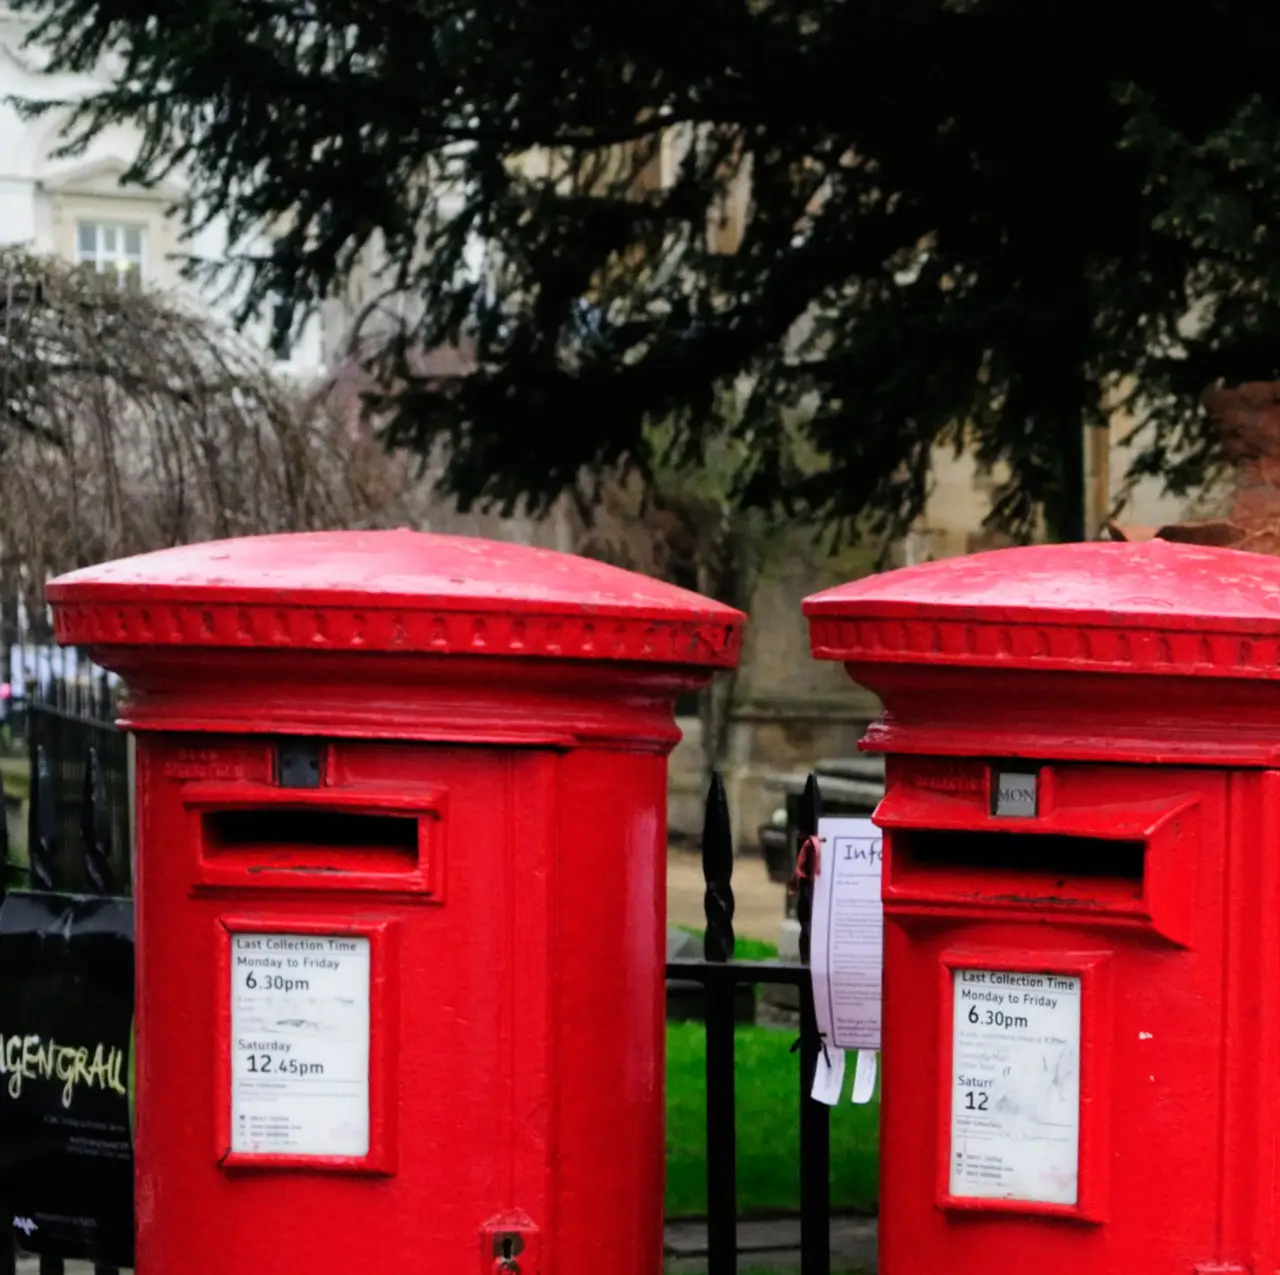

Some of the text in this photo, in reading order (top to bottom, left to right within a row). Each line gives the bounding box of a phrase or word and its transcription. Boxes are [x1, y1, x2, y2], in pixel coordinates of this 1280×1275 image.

[236, 938, 357, 951] Last Collection Time
[237, 956, 340, 970] Monday to Friday
[245, 971, 309, 992] 6.30pm
[962, 971, 1075, 991] Last Collection Time
[961, 990, 1058, 1009] Monday to Friday
[968, 1005, 1028, 1029] 6.30pm
[238, 1039, 292, 1053] Saturday
[246, 1054, 324, 1076] 12.45pm
[958, 1075, 994, 1088] Satur
